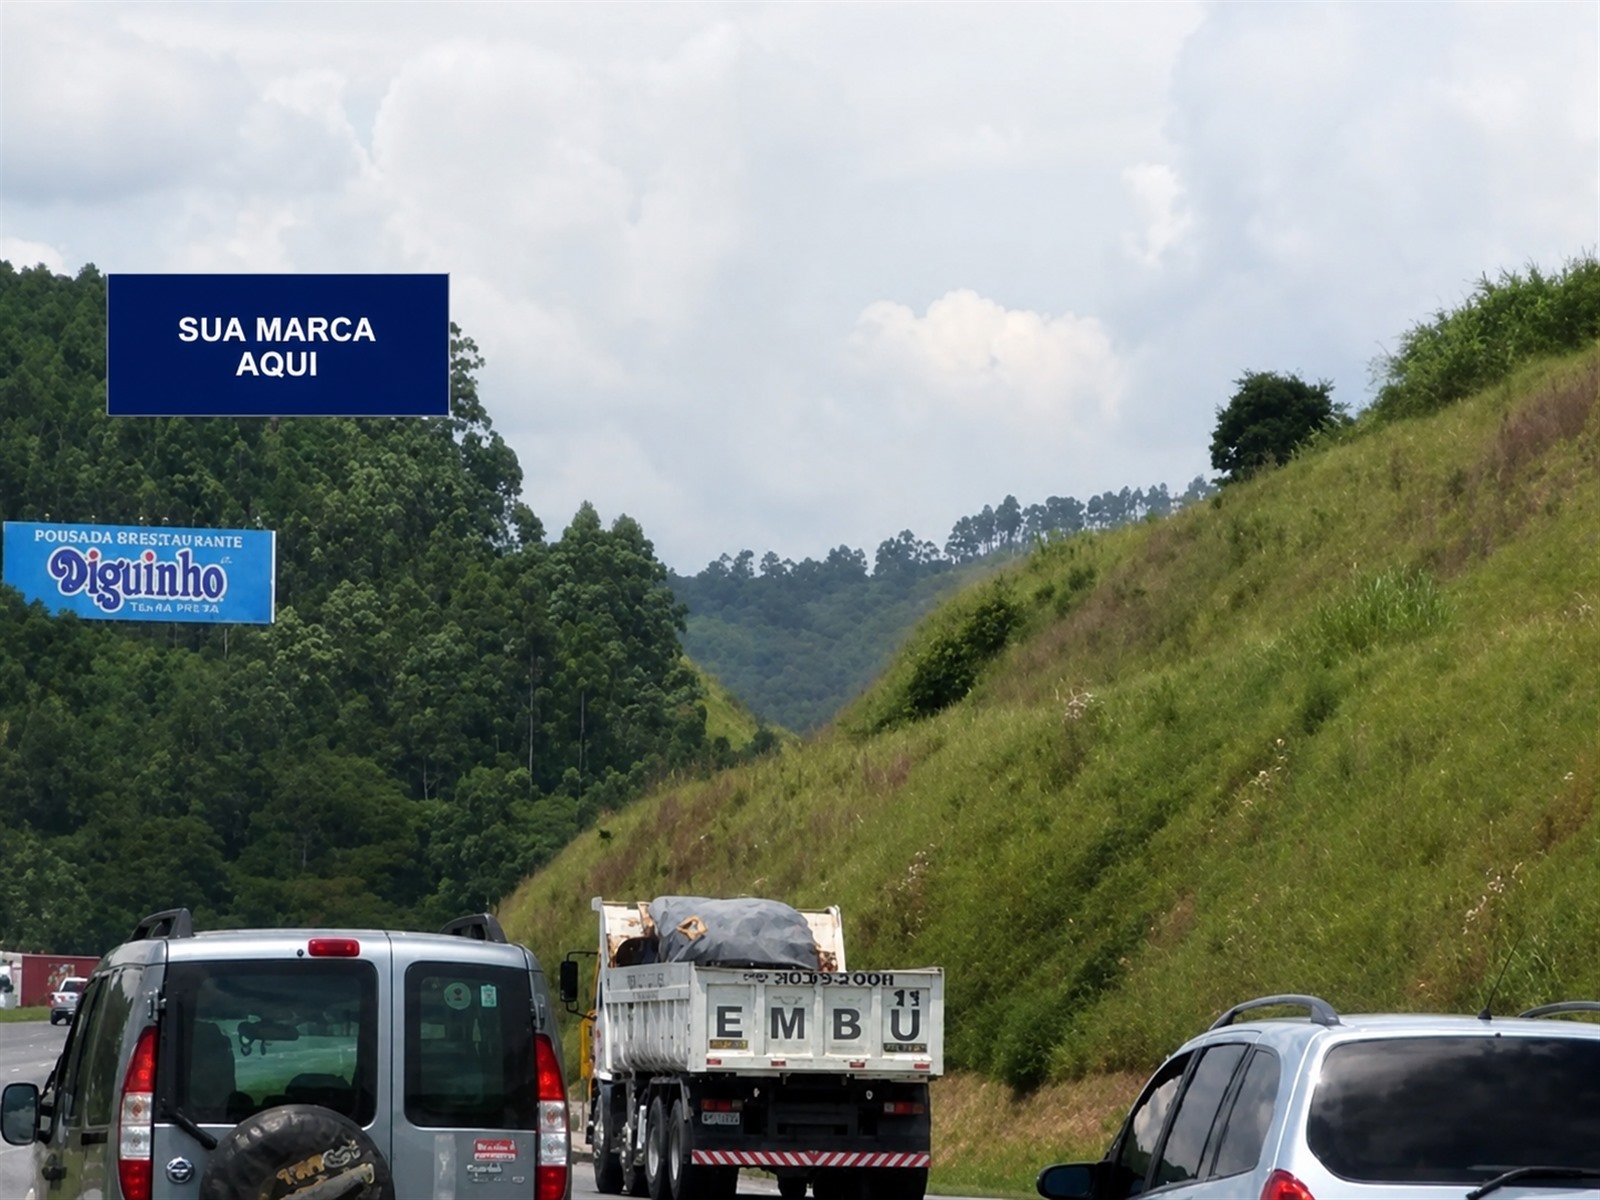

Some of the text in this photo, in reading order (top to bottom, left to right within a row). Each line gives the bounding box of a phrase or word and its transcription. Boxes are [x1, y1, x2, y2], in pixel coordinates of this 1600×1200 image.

[178, 316, 376, 342] SUA MARCA
[236, 351, 317, 378] AQUI
[34, 529, 113, 545] POUSADA
[48, 547, 227, 611] Diguinho
